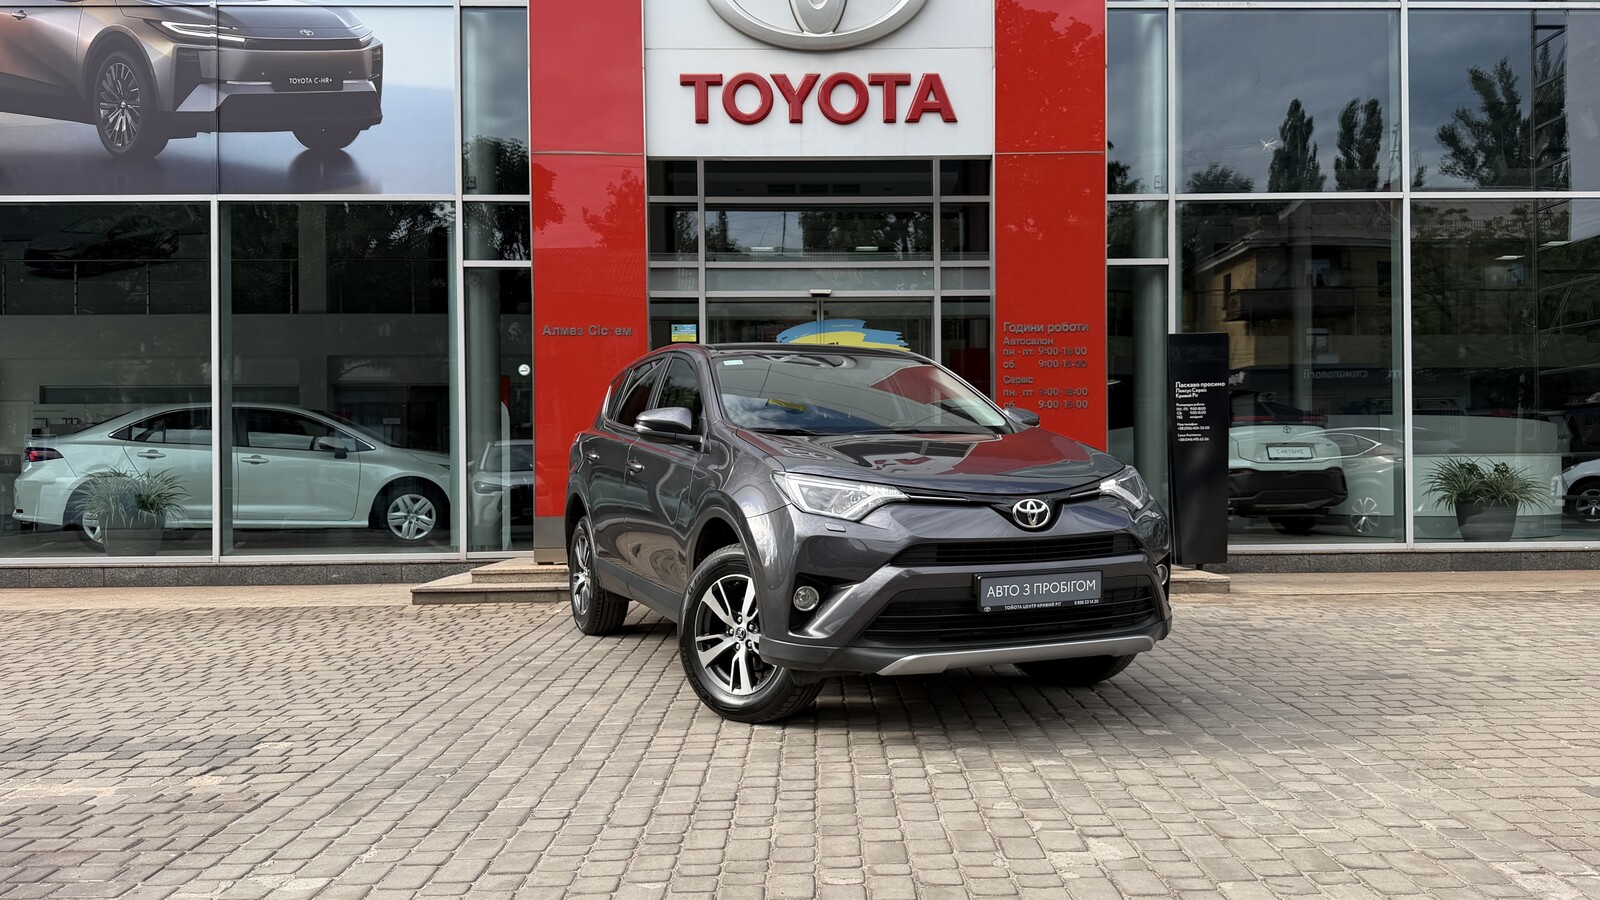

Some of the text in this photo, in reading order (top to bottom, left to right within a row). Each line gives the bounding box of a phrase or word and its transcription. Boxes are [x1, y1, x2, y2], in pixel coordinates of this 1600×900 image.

[679, 72, 958, 125] TOYOTA
[542, 325, 584, 336] Алмаз
[1003, 322, 1089, 334] Години роботи
[1003, 336, 1054, 345] Автосалон
[1003, 375, 1034, 385] Сервіс
[987, 584, 1020, 598] АВТО
[1034, 580, 1096, 595] ПРОБІГОМ
